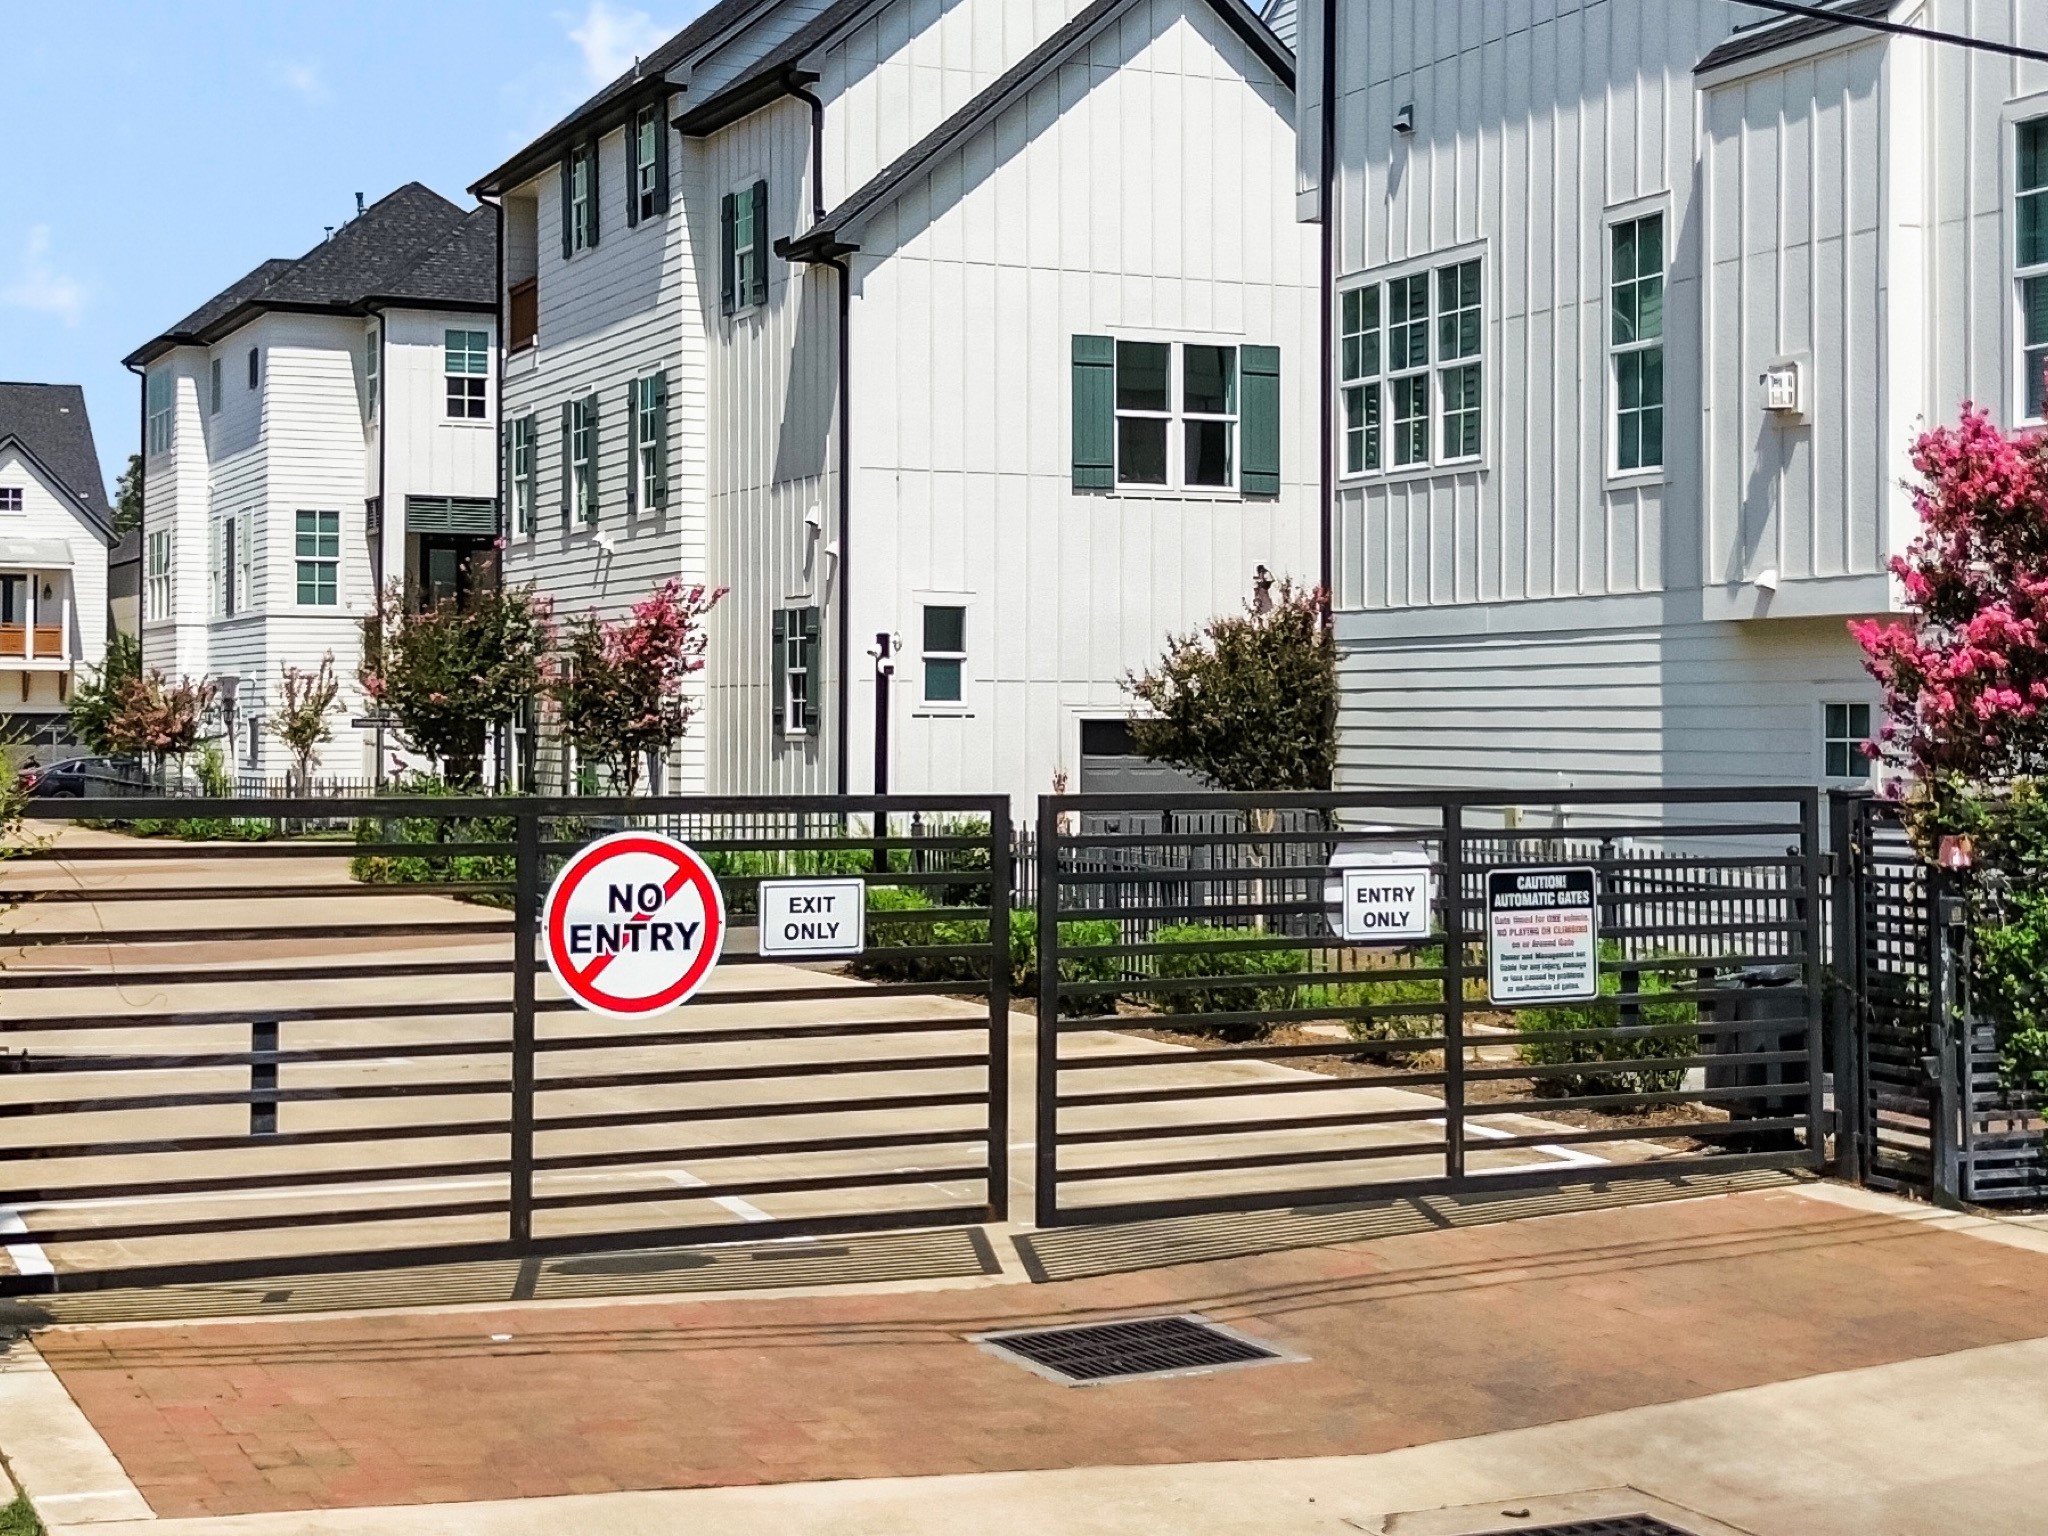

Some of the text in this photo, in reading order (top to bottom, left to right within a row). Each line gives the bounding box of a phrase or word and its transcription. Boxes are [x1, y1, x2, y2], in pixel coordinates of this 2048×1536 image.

[1516, 875, 1567, 890] CAUTION!
[608, 883, 664, 914] NO
[1357, 886, 1415, 903] ENTRY
[1494, 890, 1590, 907] AUTOMATIC GATES
[789, 896, 836, 914] EXIT
[1363, 911, 1410, 928] ONLY
[1535, 915, 1545, 923] for
[570, 922, 701, 954] ENTRY
[784, 922, 840, 940] ONLY
[1497, 929, 1507, 937] NO
[1509, 926, 1539, 936] PLAYING
[1553, 925, 1588, 934] CLIMBING
